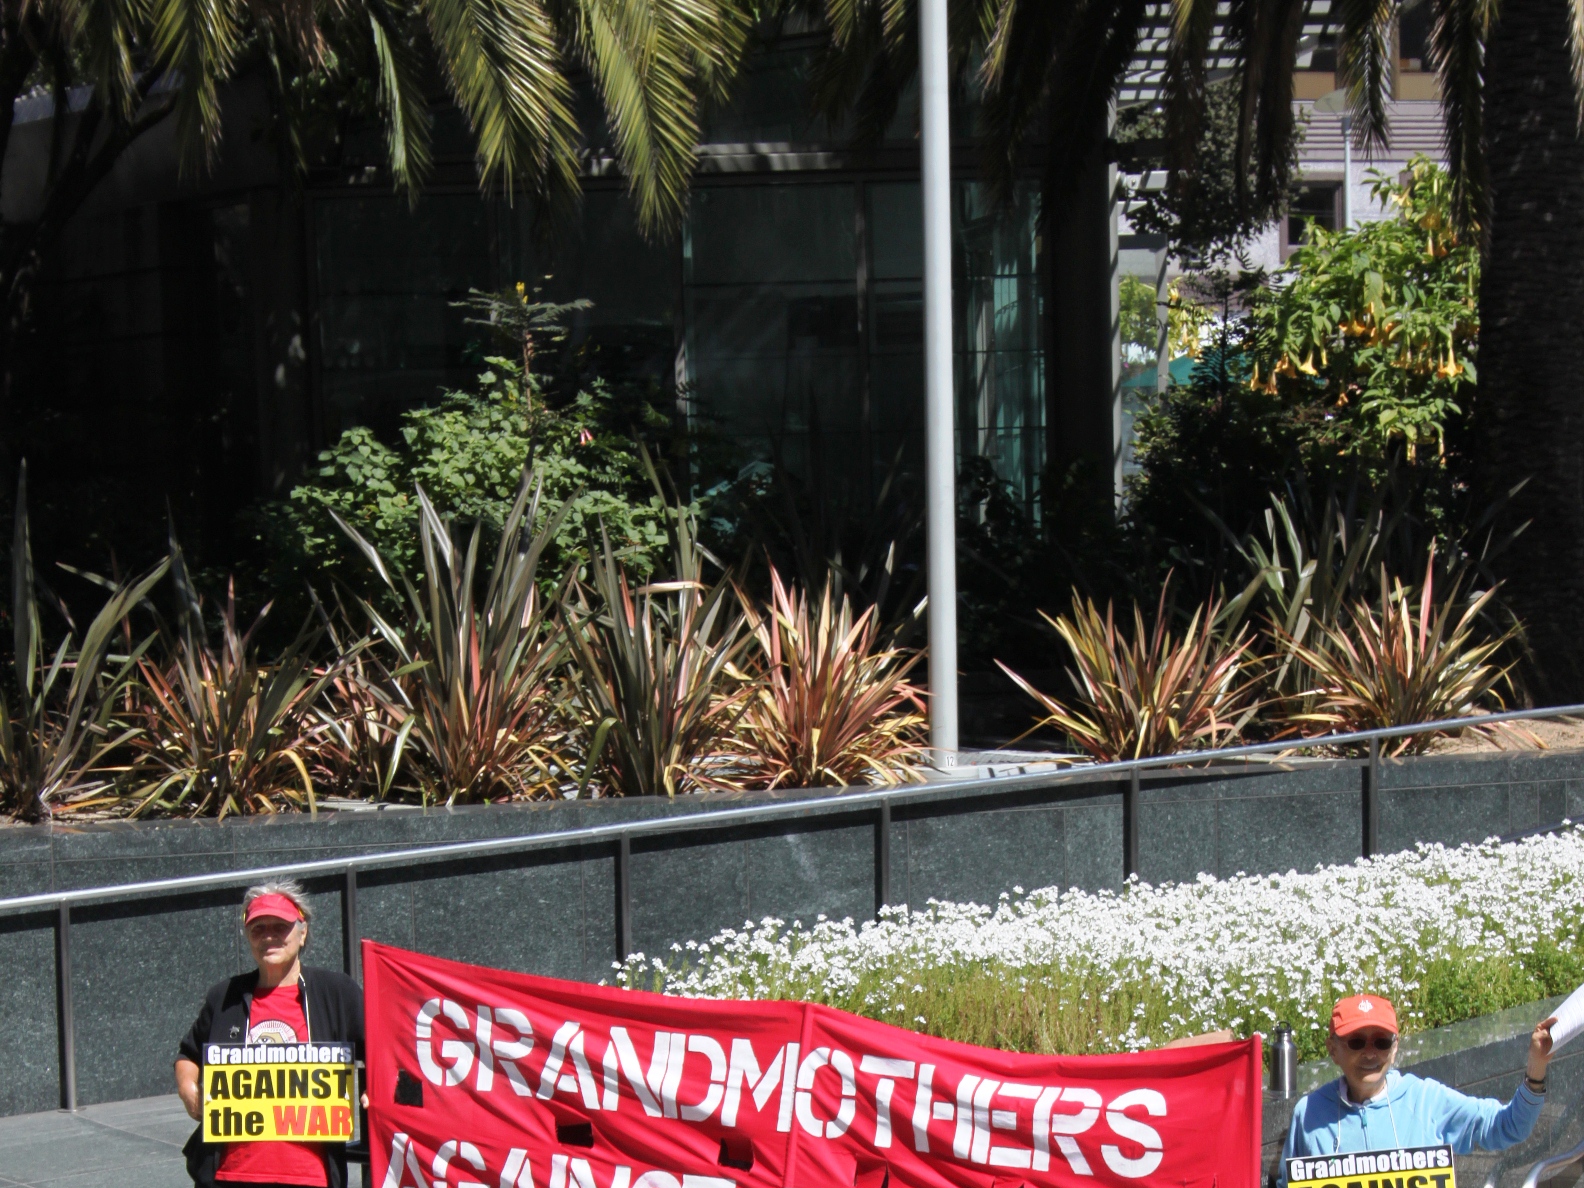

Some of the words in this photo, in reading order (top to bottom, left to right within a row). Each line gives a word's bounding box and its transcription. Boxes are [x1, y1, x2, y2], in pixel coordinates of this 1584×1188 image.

[946, 756, 954, 767] 12
[208, 1044, 351, 1065] Grandmothers
[210, 1069, 352, 1100] AGAINST
[416, 998, 1167, 1178] GRANDMOTHERS
[209, 1107, 264, 1136] the
[273, 1106, 352, 1136] WAR
[1291, 1149, 1449, 1181] Grandmothers
